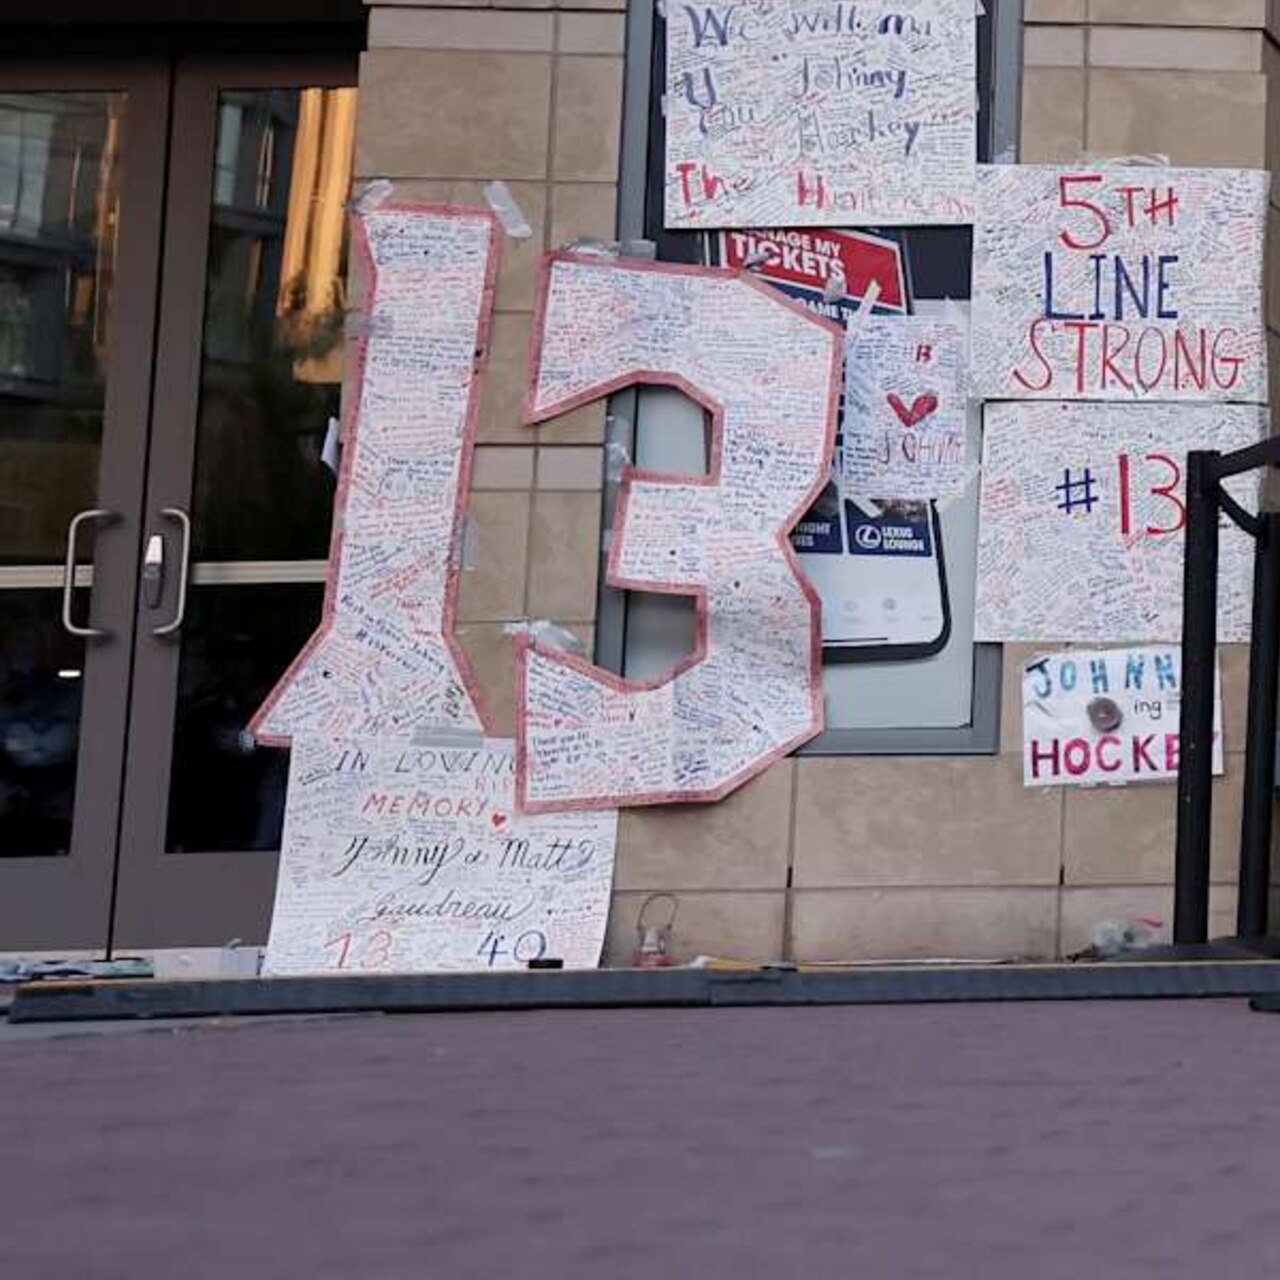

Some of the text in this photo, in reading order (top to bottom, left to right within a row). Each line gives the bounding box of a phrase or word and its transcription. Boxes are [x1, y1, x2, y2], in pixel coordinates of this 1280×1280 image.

[1059, 175, 1179, 251] 5TH
[730, 231, 847, 283] TICKETS
[814, 236, 842, 258] MY
[1043, 251, 1179, 322] LINE
[1012, 318, 1246, 394] STRONG
[1026, 655, 1180, 699] JOHNN
[334, 748, 370, 773] IN
[1030, 734, 1182, 779] HOCKE
[361, 792, 489, 819] MEMORY
